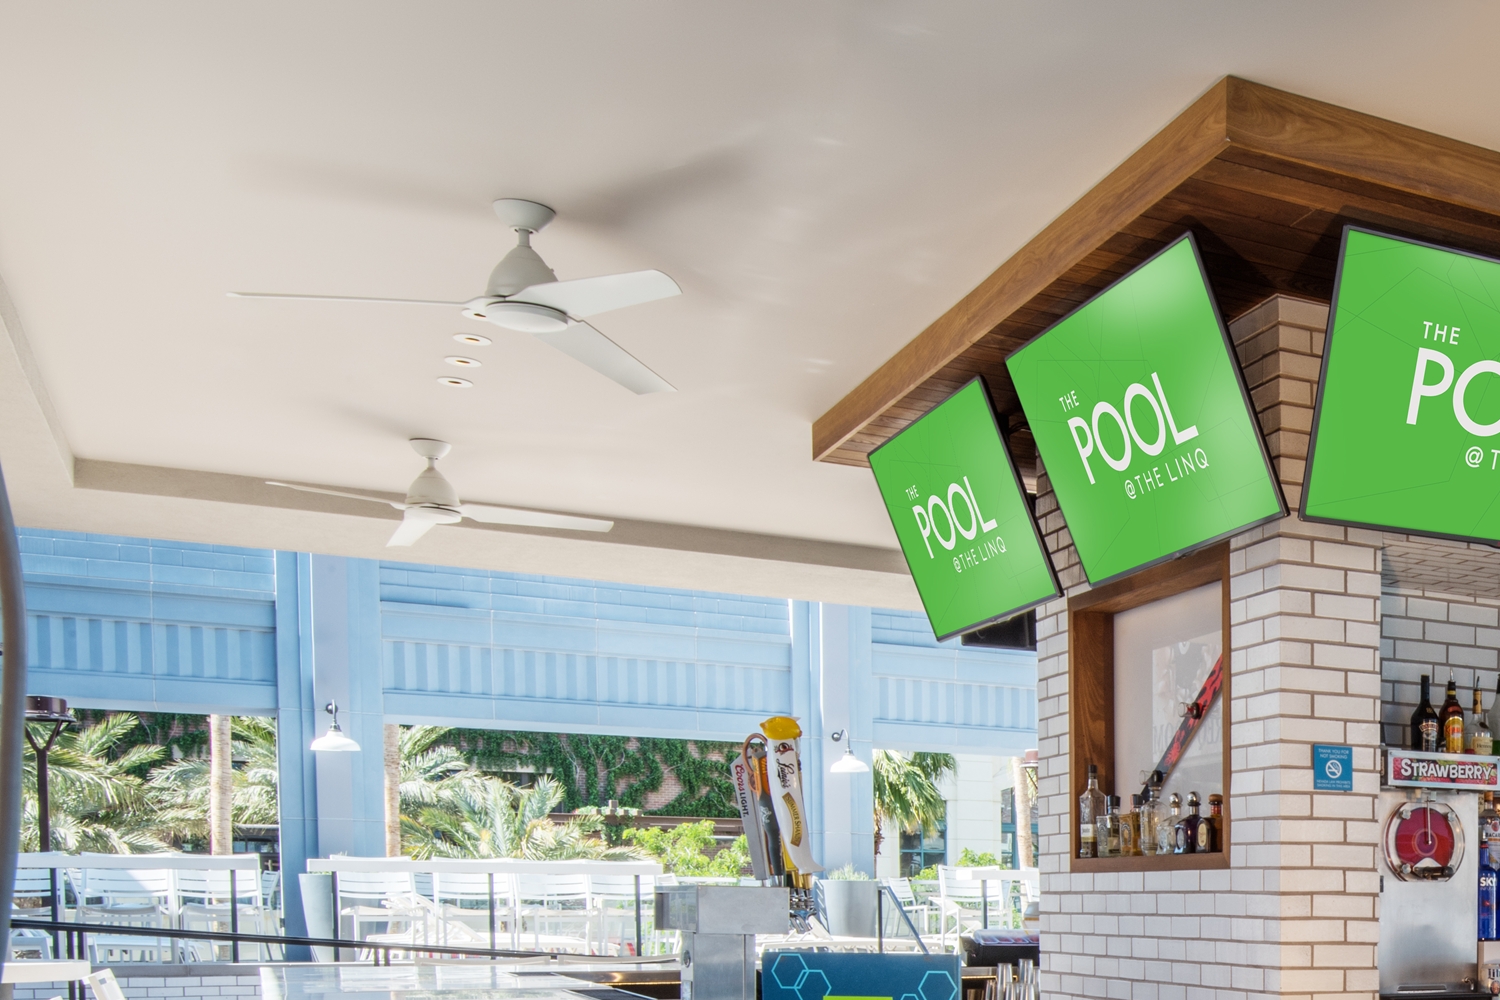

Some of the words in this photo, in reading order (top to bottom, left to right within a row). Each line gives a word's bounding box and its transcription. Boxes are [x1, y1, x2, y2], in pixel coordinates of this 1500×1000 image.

[1423, 320, 1461, 346] THE
[1059, 390, 1080, 412] THE
[1066, 371, 1199, 485] POOL
[1166, 447, 1210, 482] LINQ
[905, 484, 920, 501] THE
[912, 475, 999, 560] POOL
[978, 536, 1008, 564] LINQ
[735, 763, 746, 792] Coors
[1400, 758, 1493, 780] STRAWBERRY
[739, 792, 749, 817] LIGHT
[785, 796, 800, 820] SUMMER
